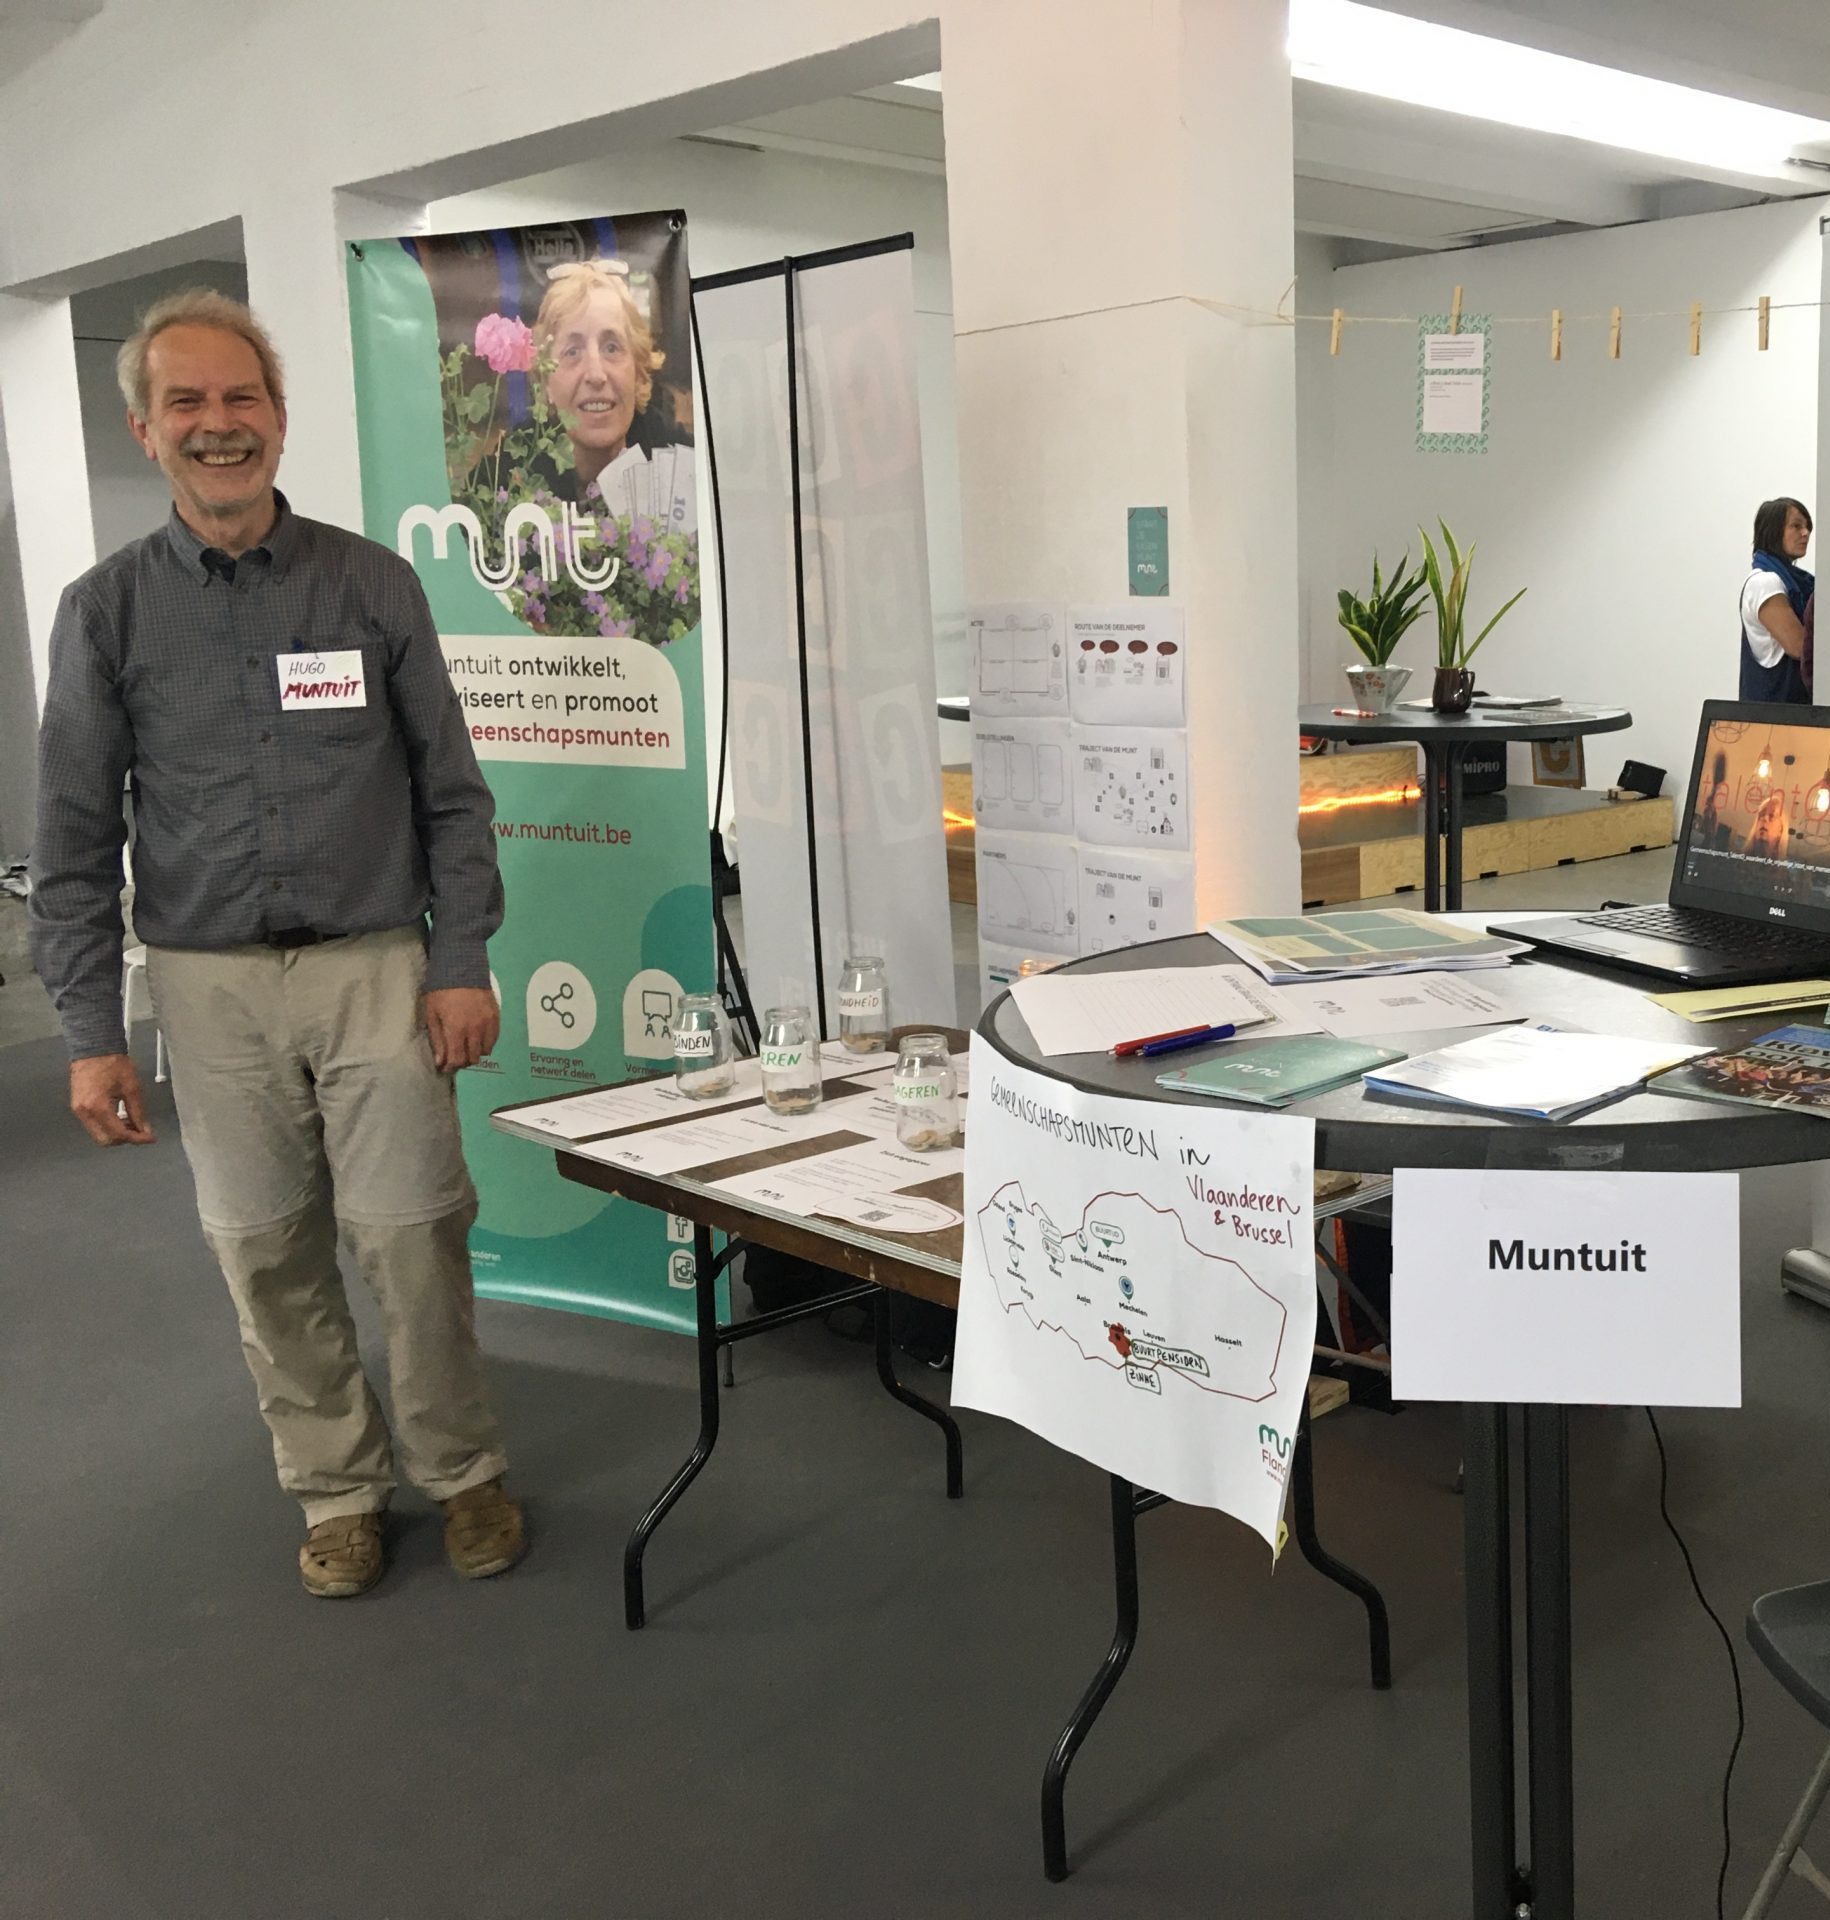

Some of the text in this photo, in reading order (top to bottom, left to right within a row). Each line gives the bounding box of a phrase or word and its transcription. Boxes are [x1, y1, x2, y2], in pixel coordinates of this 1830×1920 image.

[398, 502, 620, 592] munt
[289, 661, 325, 676] HUGO
[509, 655, 626, 680] ontwikkelt,
[532, 693, 557, 710] en
[565, 693, 659, 716] promoot
[471, 722, 670, 750] eenschapsmunten
[1769, 907, 1786, 917] DELL
[530, 1052, 583, 1069] Ervaring en
[531, 1065, 596, 1080] netwerk delen
[1180, 1136, 1210, 1165] in
[1186, 1174, 1300, 1215] Vlaanderen
[1214, 1210, 1293, 1248] & Brussel
[1098, 1251, 1127, 1266] Antwerp
[1489, 1239, 1646, 1272] Muntuit
[1118, 1302, 1148, 1317] Mechelen
[1143, 1329, 1166, 1343] Leuven
[1214, 1334, 1243, 1347] Hasselt
